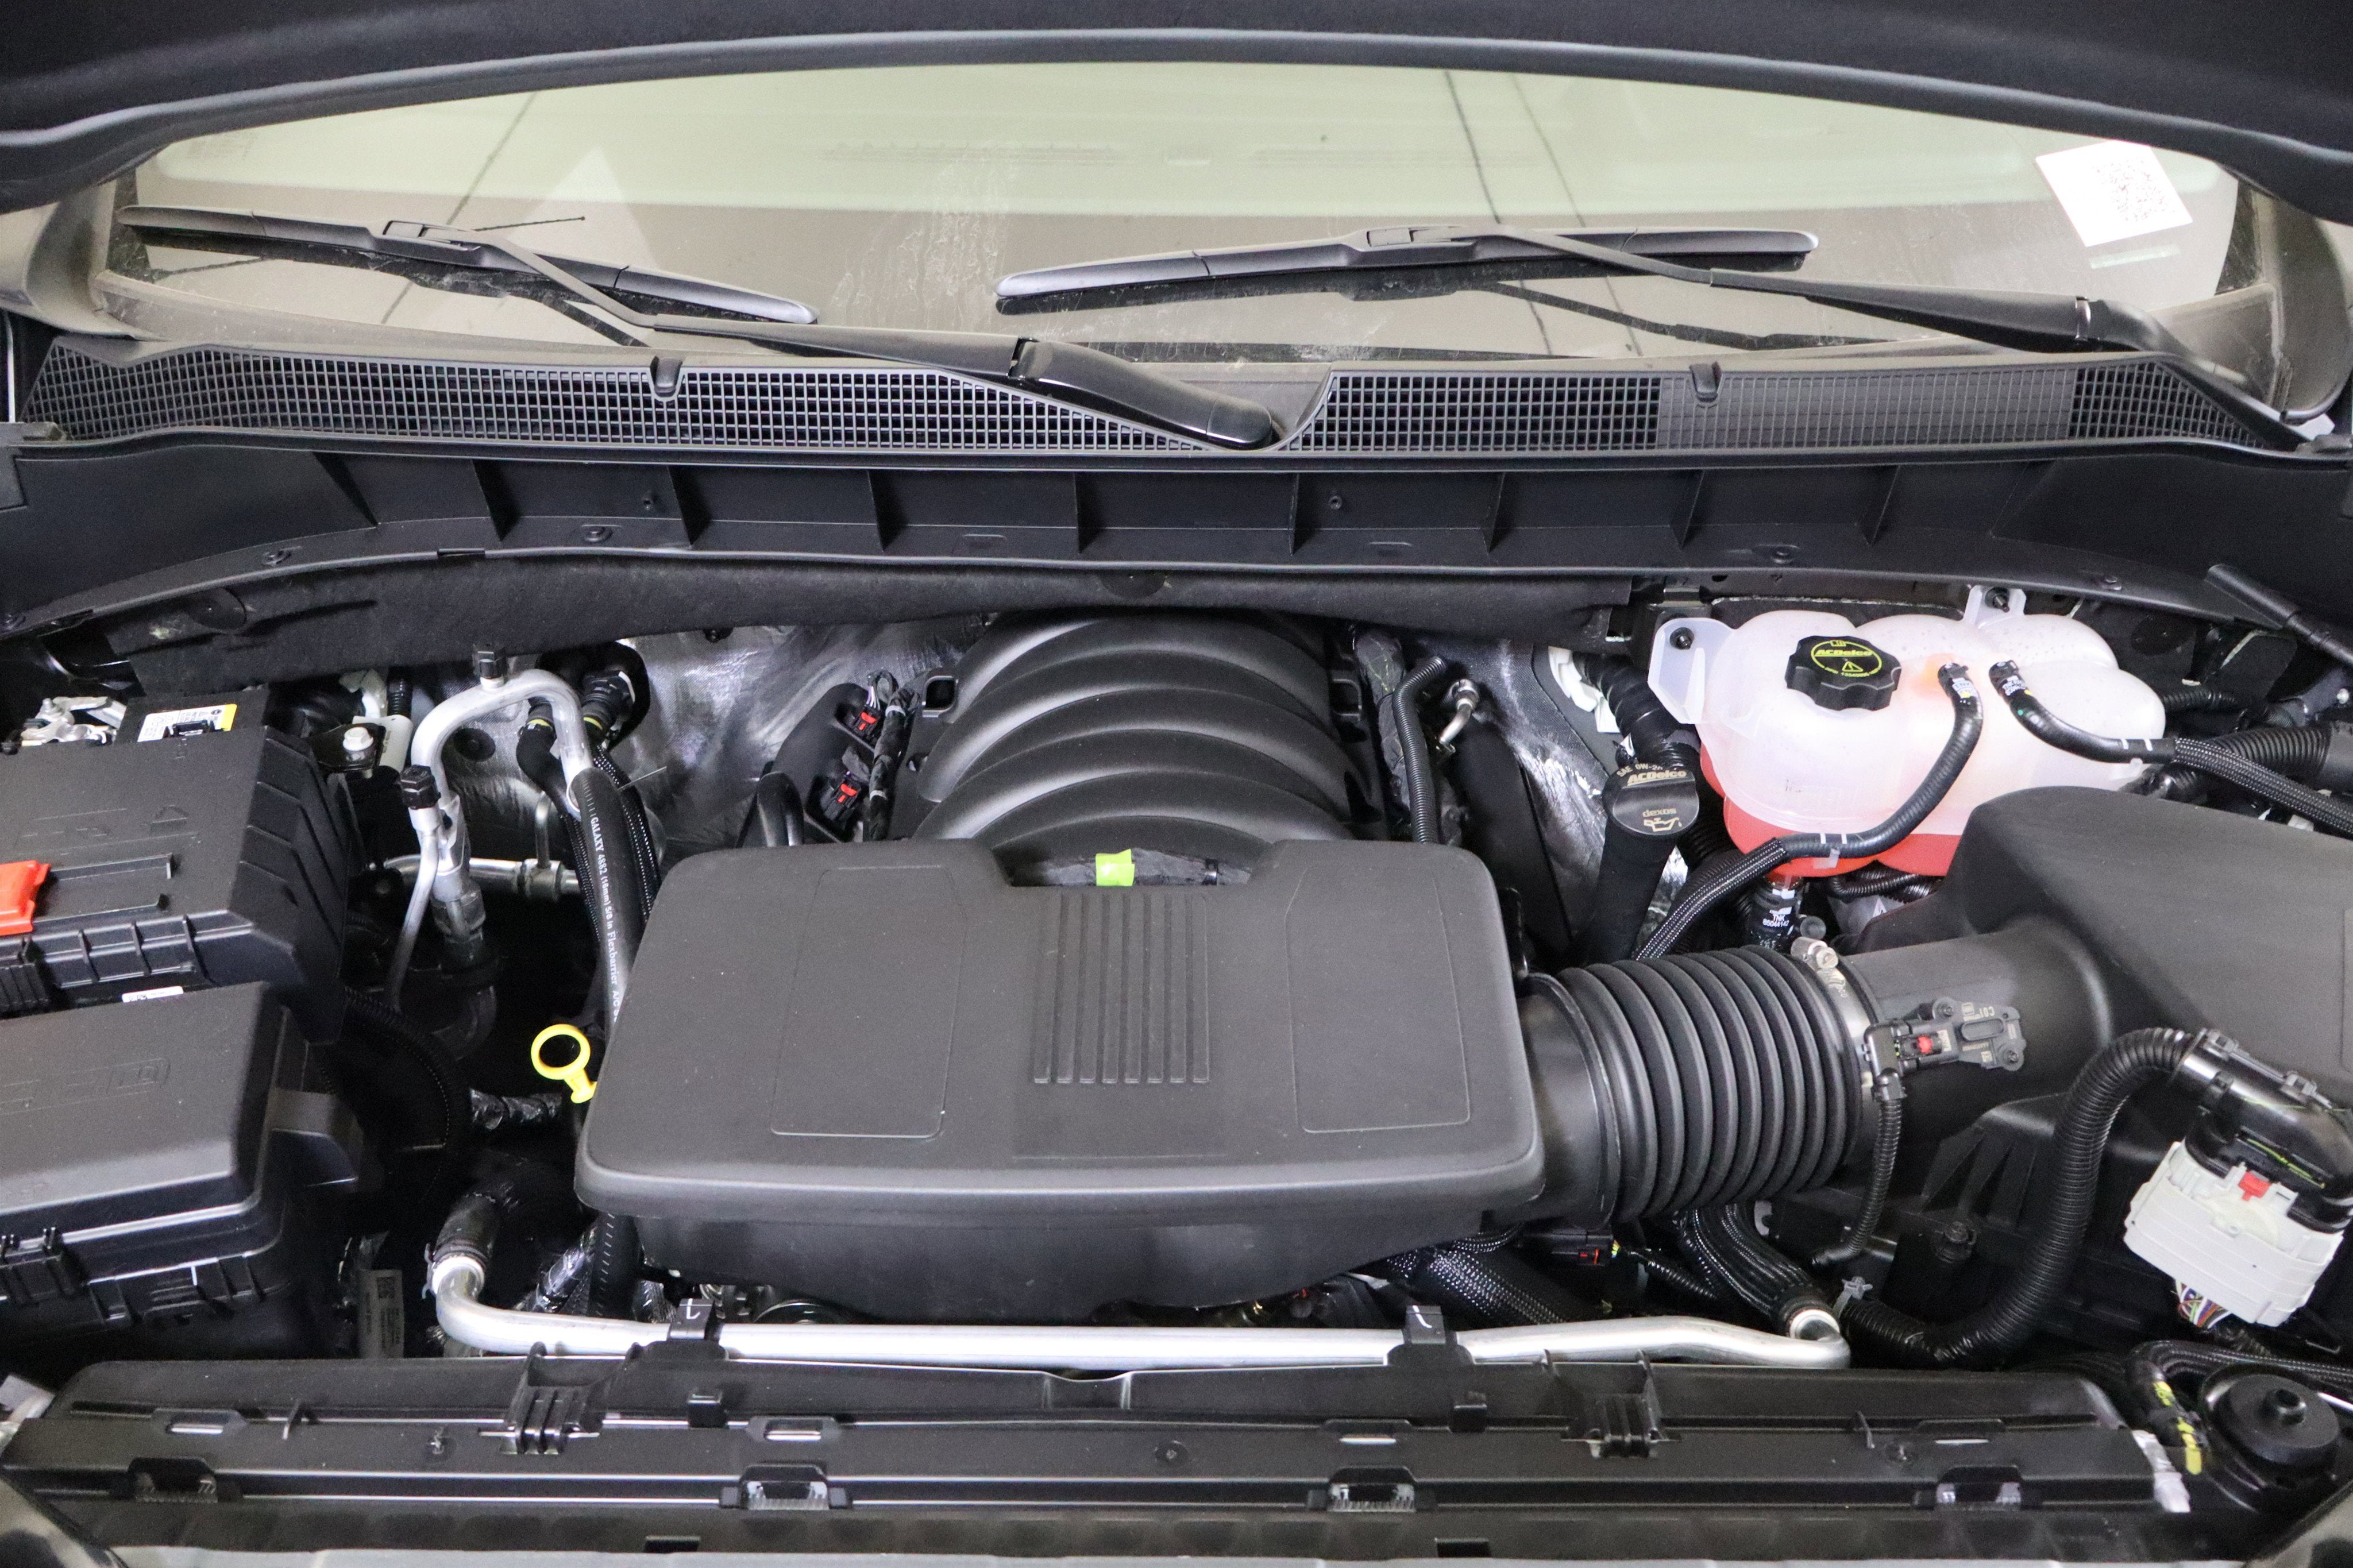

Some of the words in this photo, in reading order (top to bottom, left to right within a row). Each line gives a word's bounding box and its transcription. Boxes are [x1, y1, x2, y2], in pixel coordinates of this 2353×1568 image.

[1617, 766, 1633, 777] SAE
[1627, 770, 1687, 784] ACDelco
[1642, 808, 1677, 817] dexos
[591, 817, 604, 851] GALAXY
[597, 854, 608, 875] 4882
[600, 876, 611, 905] (16mm)
[605, 906, 613, 920] 5/8
[607, 930, 619, 984] Flexbarrier
